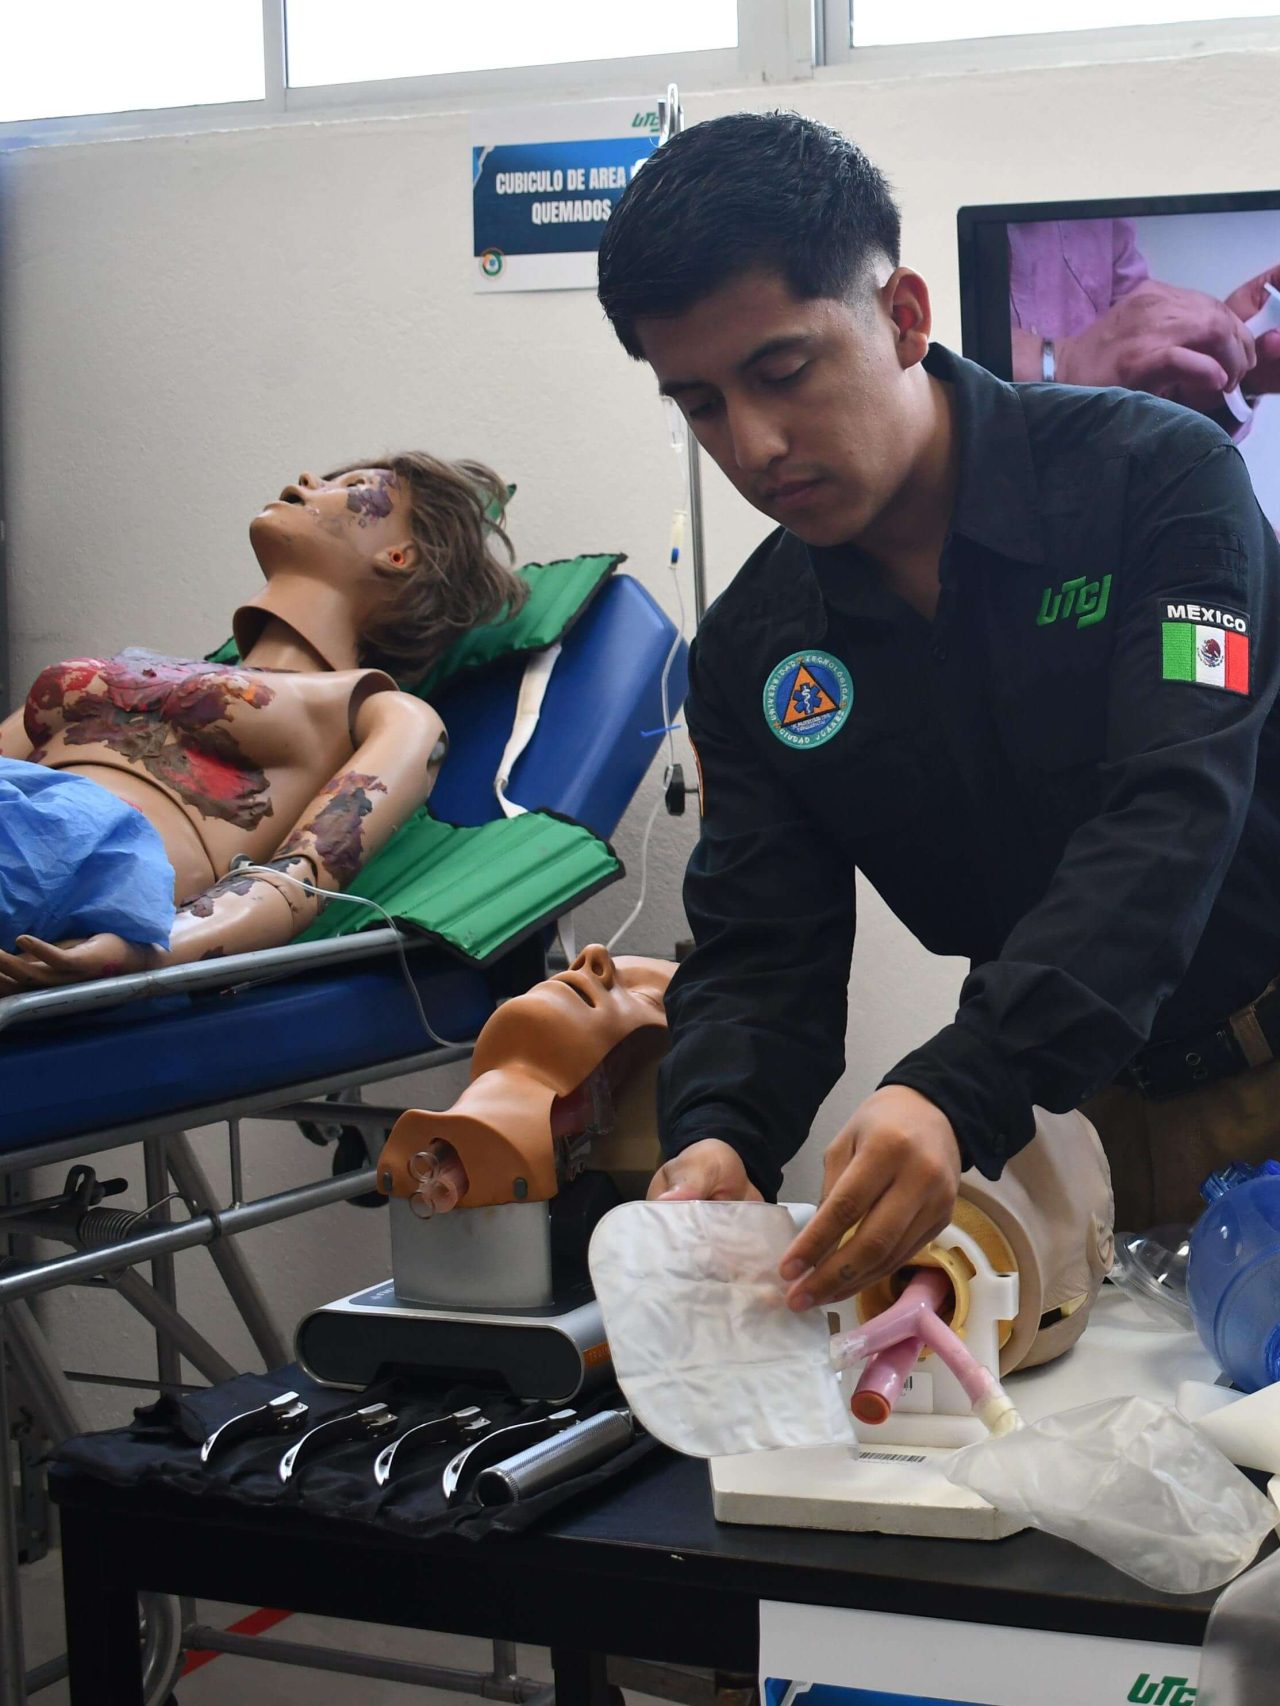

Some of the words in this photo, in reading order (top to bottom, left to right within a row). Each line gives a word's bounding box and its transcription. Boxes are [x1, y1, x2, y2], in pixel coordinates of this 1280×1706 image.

[632, 112, 660, 132] UTC
[496, 169, 563, 194] CUBICULO
[567, 169, 585, 191] DE
[589, 166, 626, 189] AREA
[532, 199, 612, 225] QUEMADOS
[1036, 574, 1112, 629] UTCJ
[1167, 604, 1246, 632] MEXICO
[779, 729, 810, 743] CIUDAD
[1127, 1673, 1197, 1706] UTC
